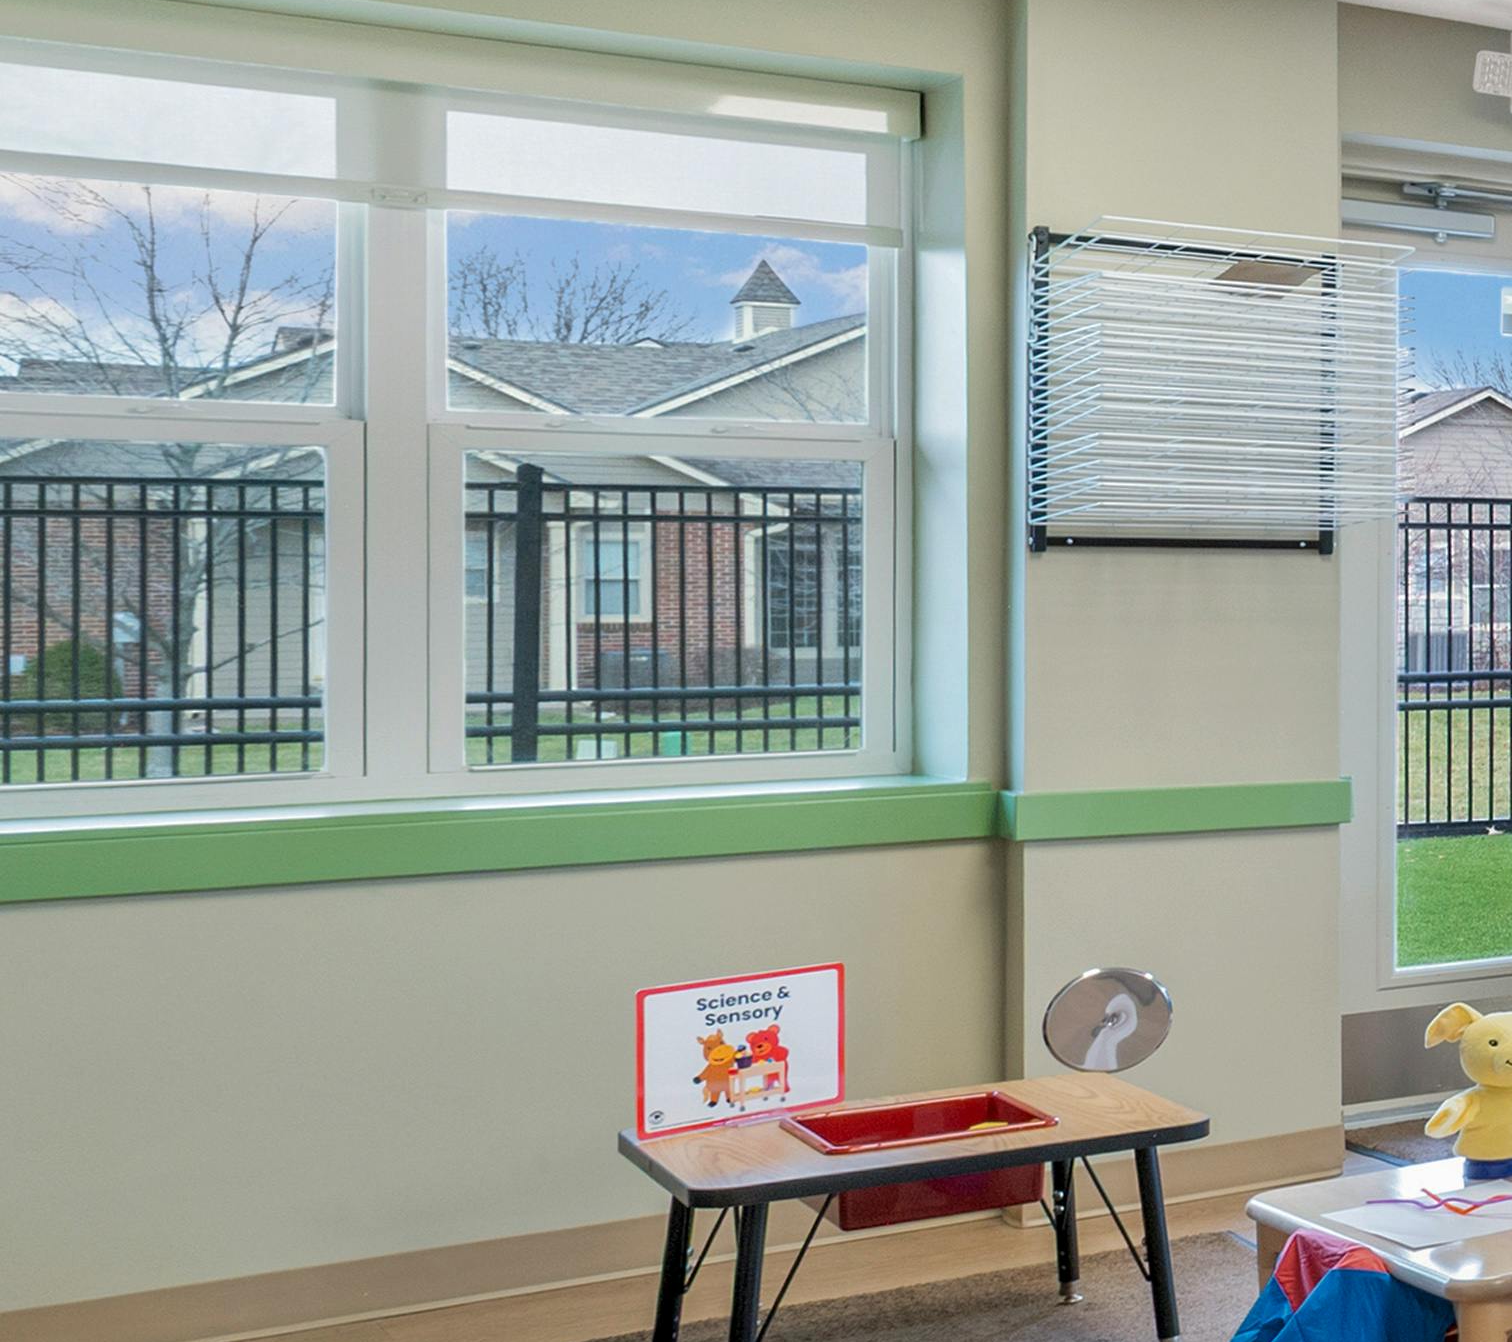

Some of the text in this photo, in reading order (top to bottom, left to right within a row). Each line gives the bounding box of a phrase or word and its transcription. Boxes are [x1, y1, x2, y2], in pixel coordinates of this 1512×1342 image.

[696, 986, 790, 1012] Science &
[705, 1005, 783, 1027] Sensory
